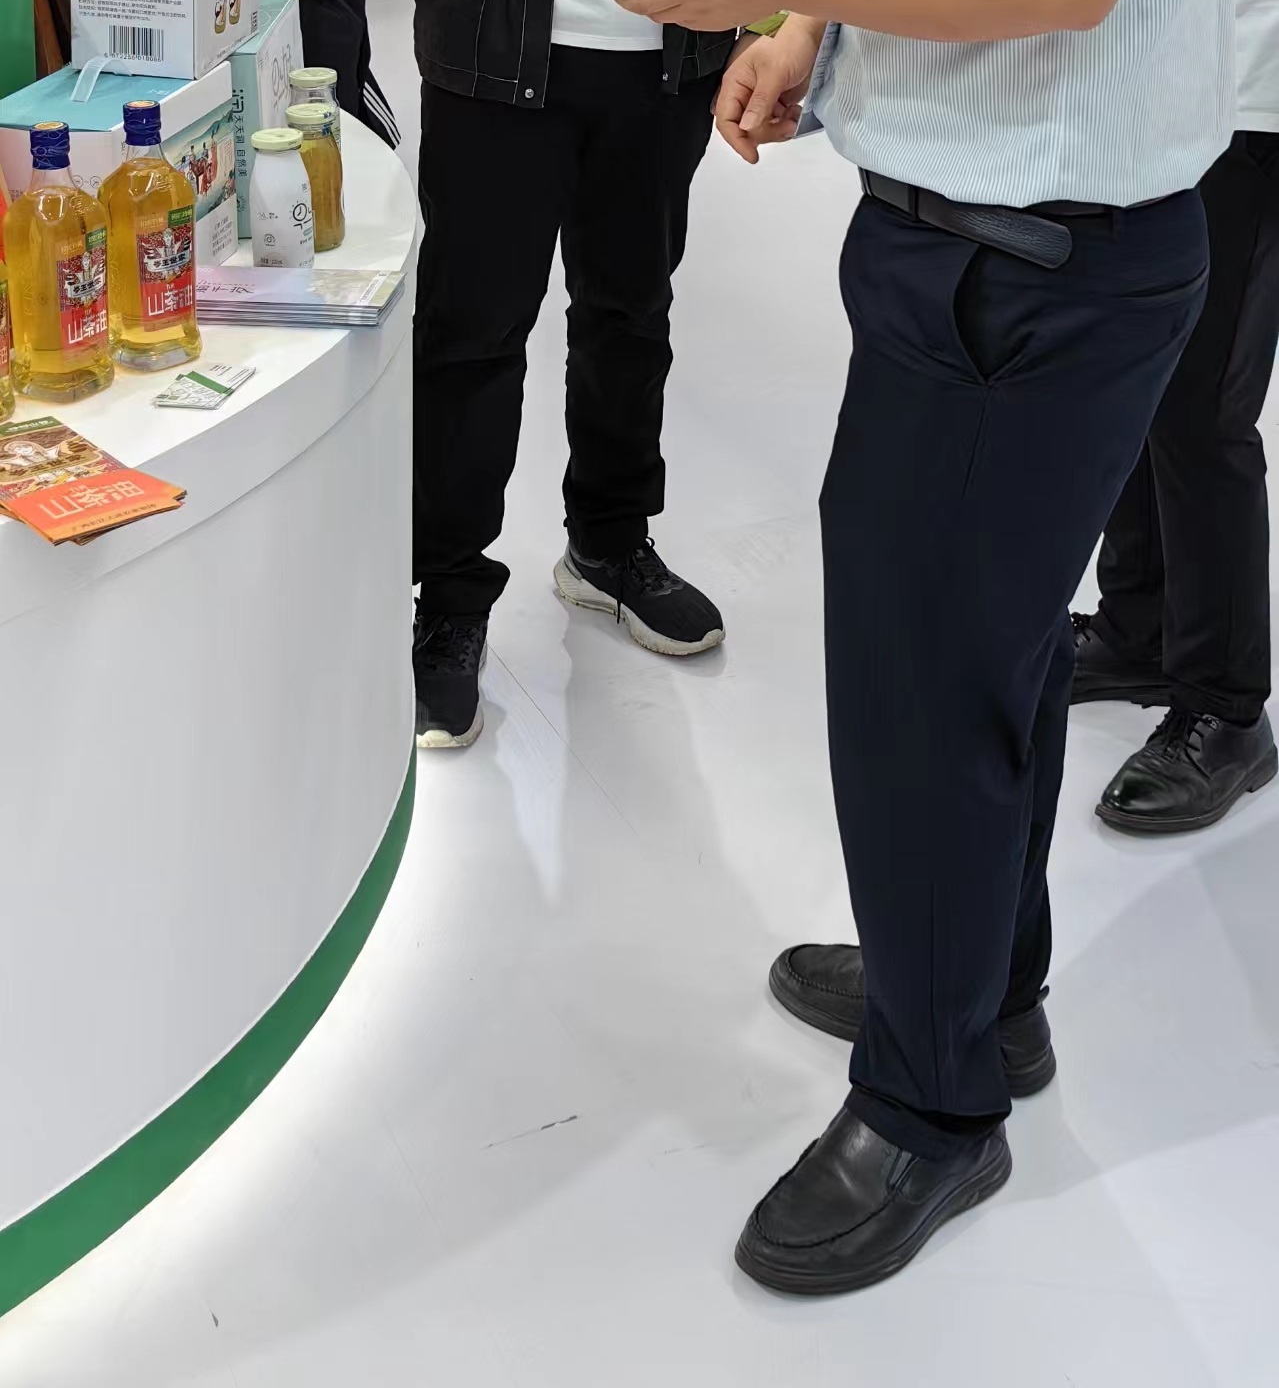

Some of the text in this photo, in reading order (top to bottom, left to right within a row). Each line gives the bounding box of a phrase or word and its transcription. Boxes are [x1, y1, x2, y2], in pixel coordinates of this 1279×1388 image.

[148, 285, 193, 316] 山茶油
[68, 310, 108, 345] 山茶油
[40, 480, 144, 519] 山茶油
